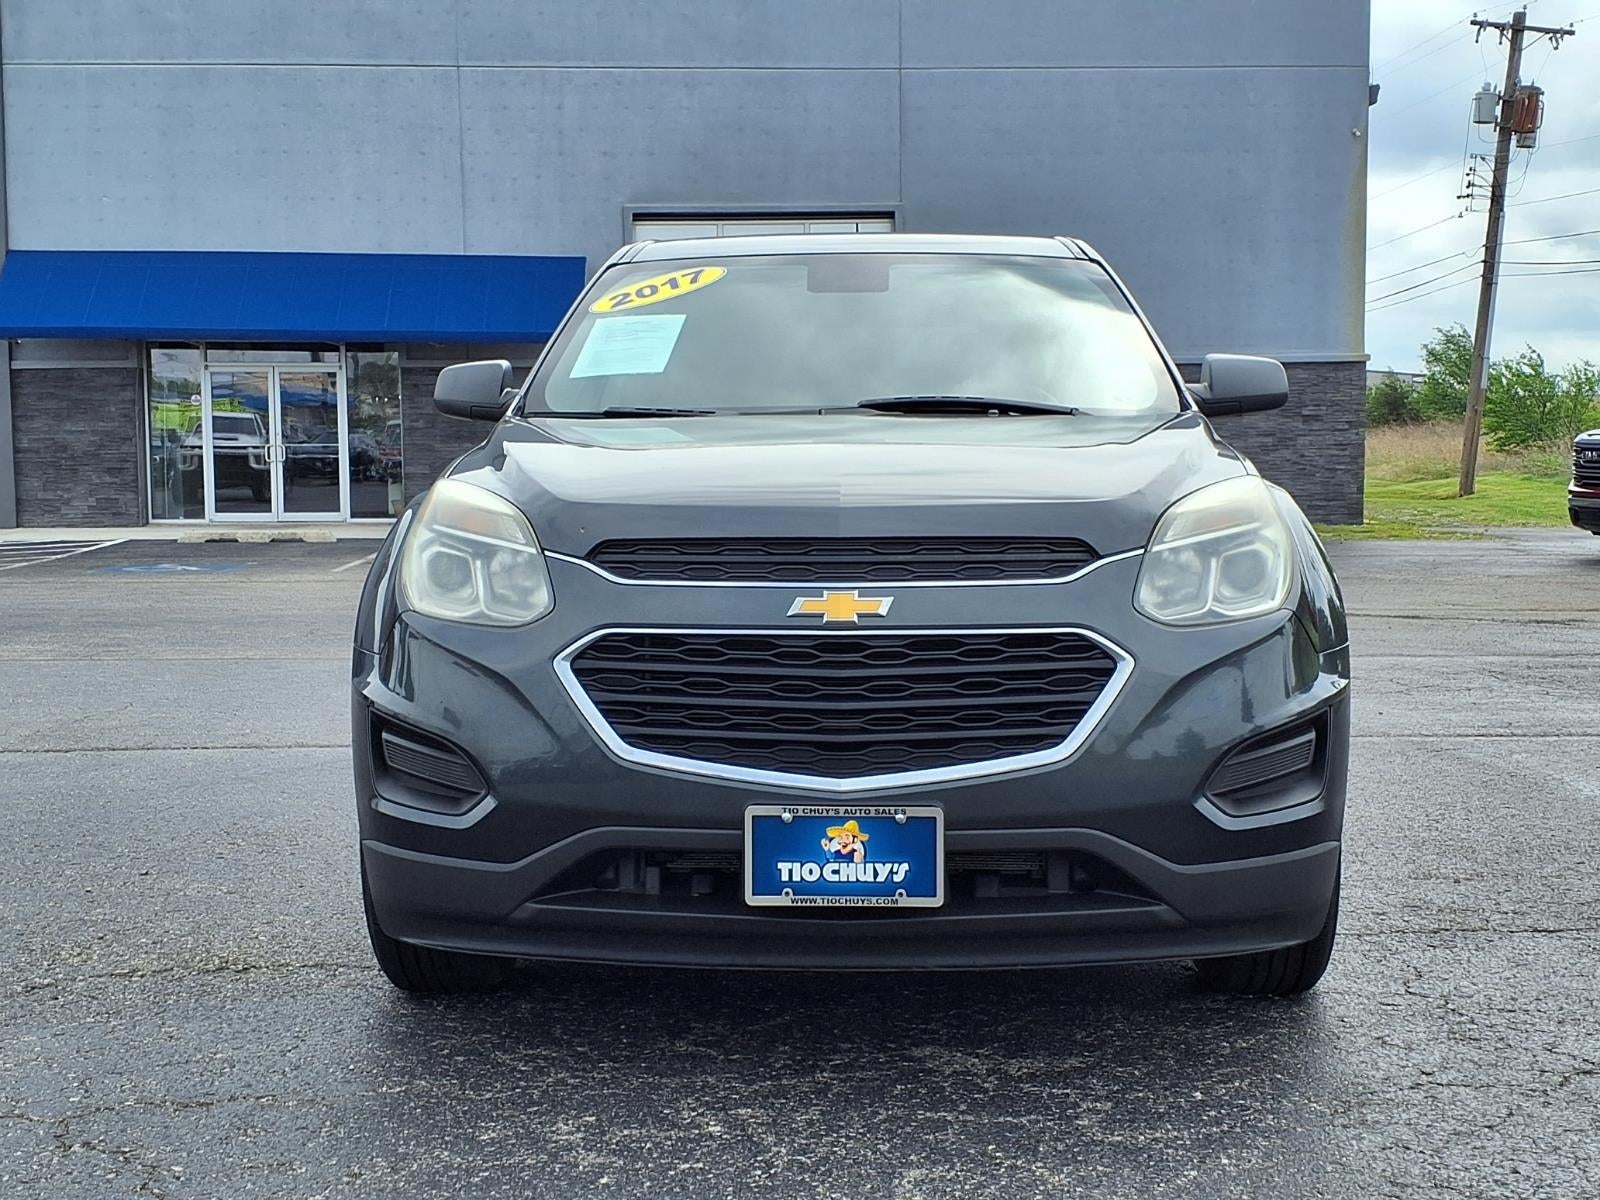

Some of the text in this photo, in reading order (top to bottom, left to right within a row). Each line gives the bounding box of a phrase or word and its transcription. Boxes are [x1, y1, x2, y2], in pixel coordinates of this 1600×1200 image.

[608, 269, 705, 309] 2017
[782, 807, 799, 815] TIO
[843, 808, 871, 816] AUTO
[874, 808, 907, 816] SALES
[790, 897, 899, 905] WWW.TIOCHUYS.COM
